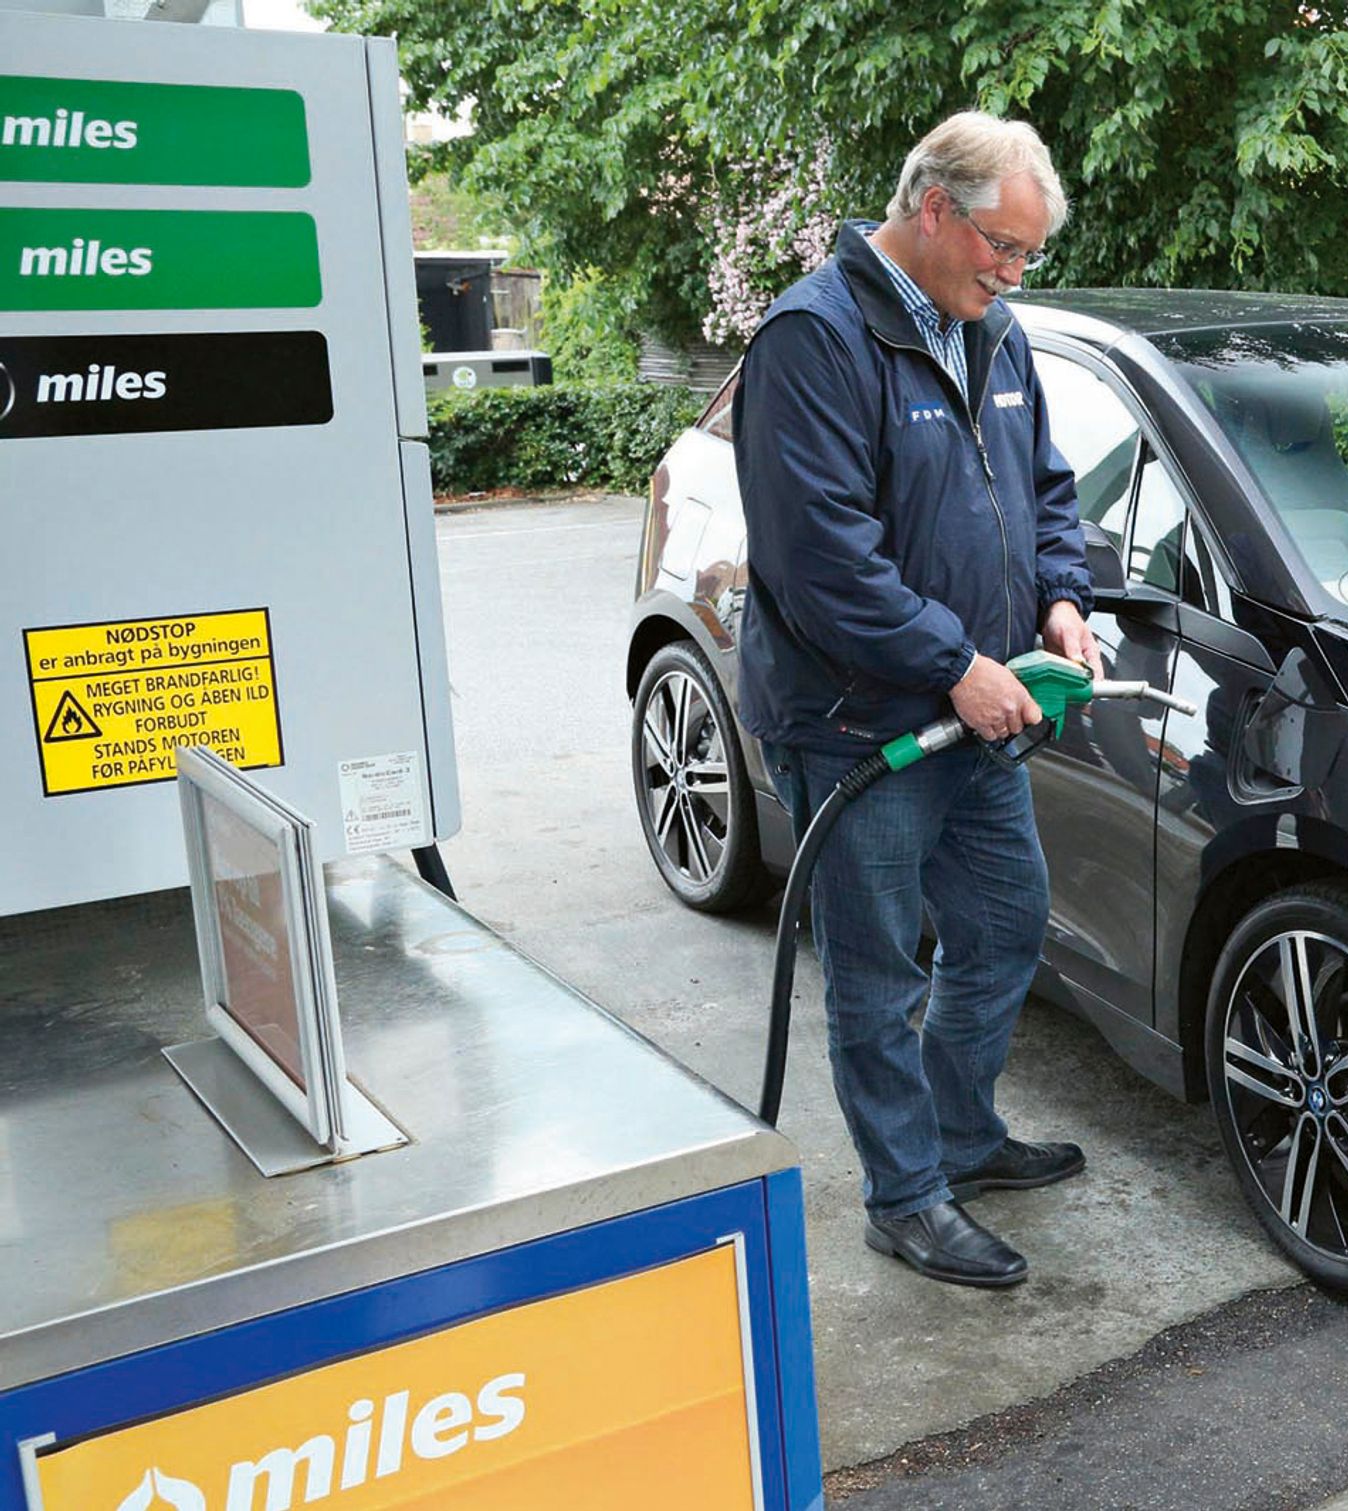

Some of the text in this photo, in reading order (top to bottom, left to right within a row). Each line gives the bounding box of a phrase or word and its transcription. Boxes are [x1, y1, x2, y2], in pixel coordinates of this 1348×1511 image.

[2, 109, 138, 149] miles
[19, 238, 153, 277] miles
[36, 364, 167, 403] miles
[106, 622, 196, 645] NØDSTOP
[39, 636, 261, 670] er anbragt på bygningen
[86, 666, 261, 699] MEGET BRANDFARLIG!
[93, 684, 269, 718] RYGNING OG ÅBEN ILD
[135, 711, 208, 733] FORBUDT
[94, 728, 241, 759] STANDS MOTOREN
[92, 747, 245, 779] FØR PÅFYLGEN
[227, 1373, 526, 1511] miles
